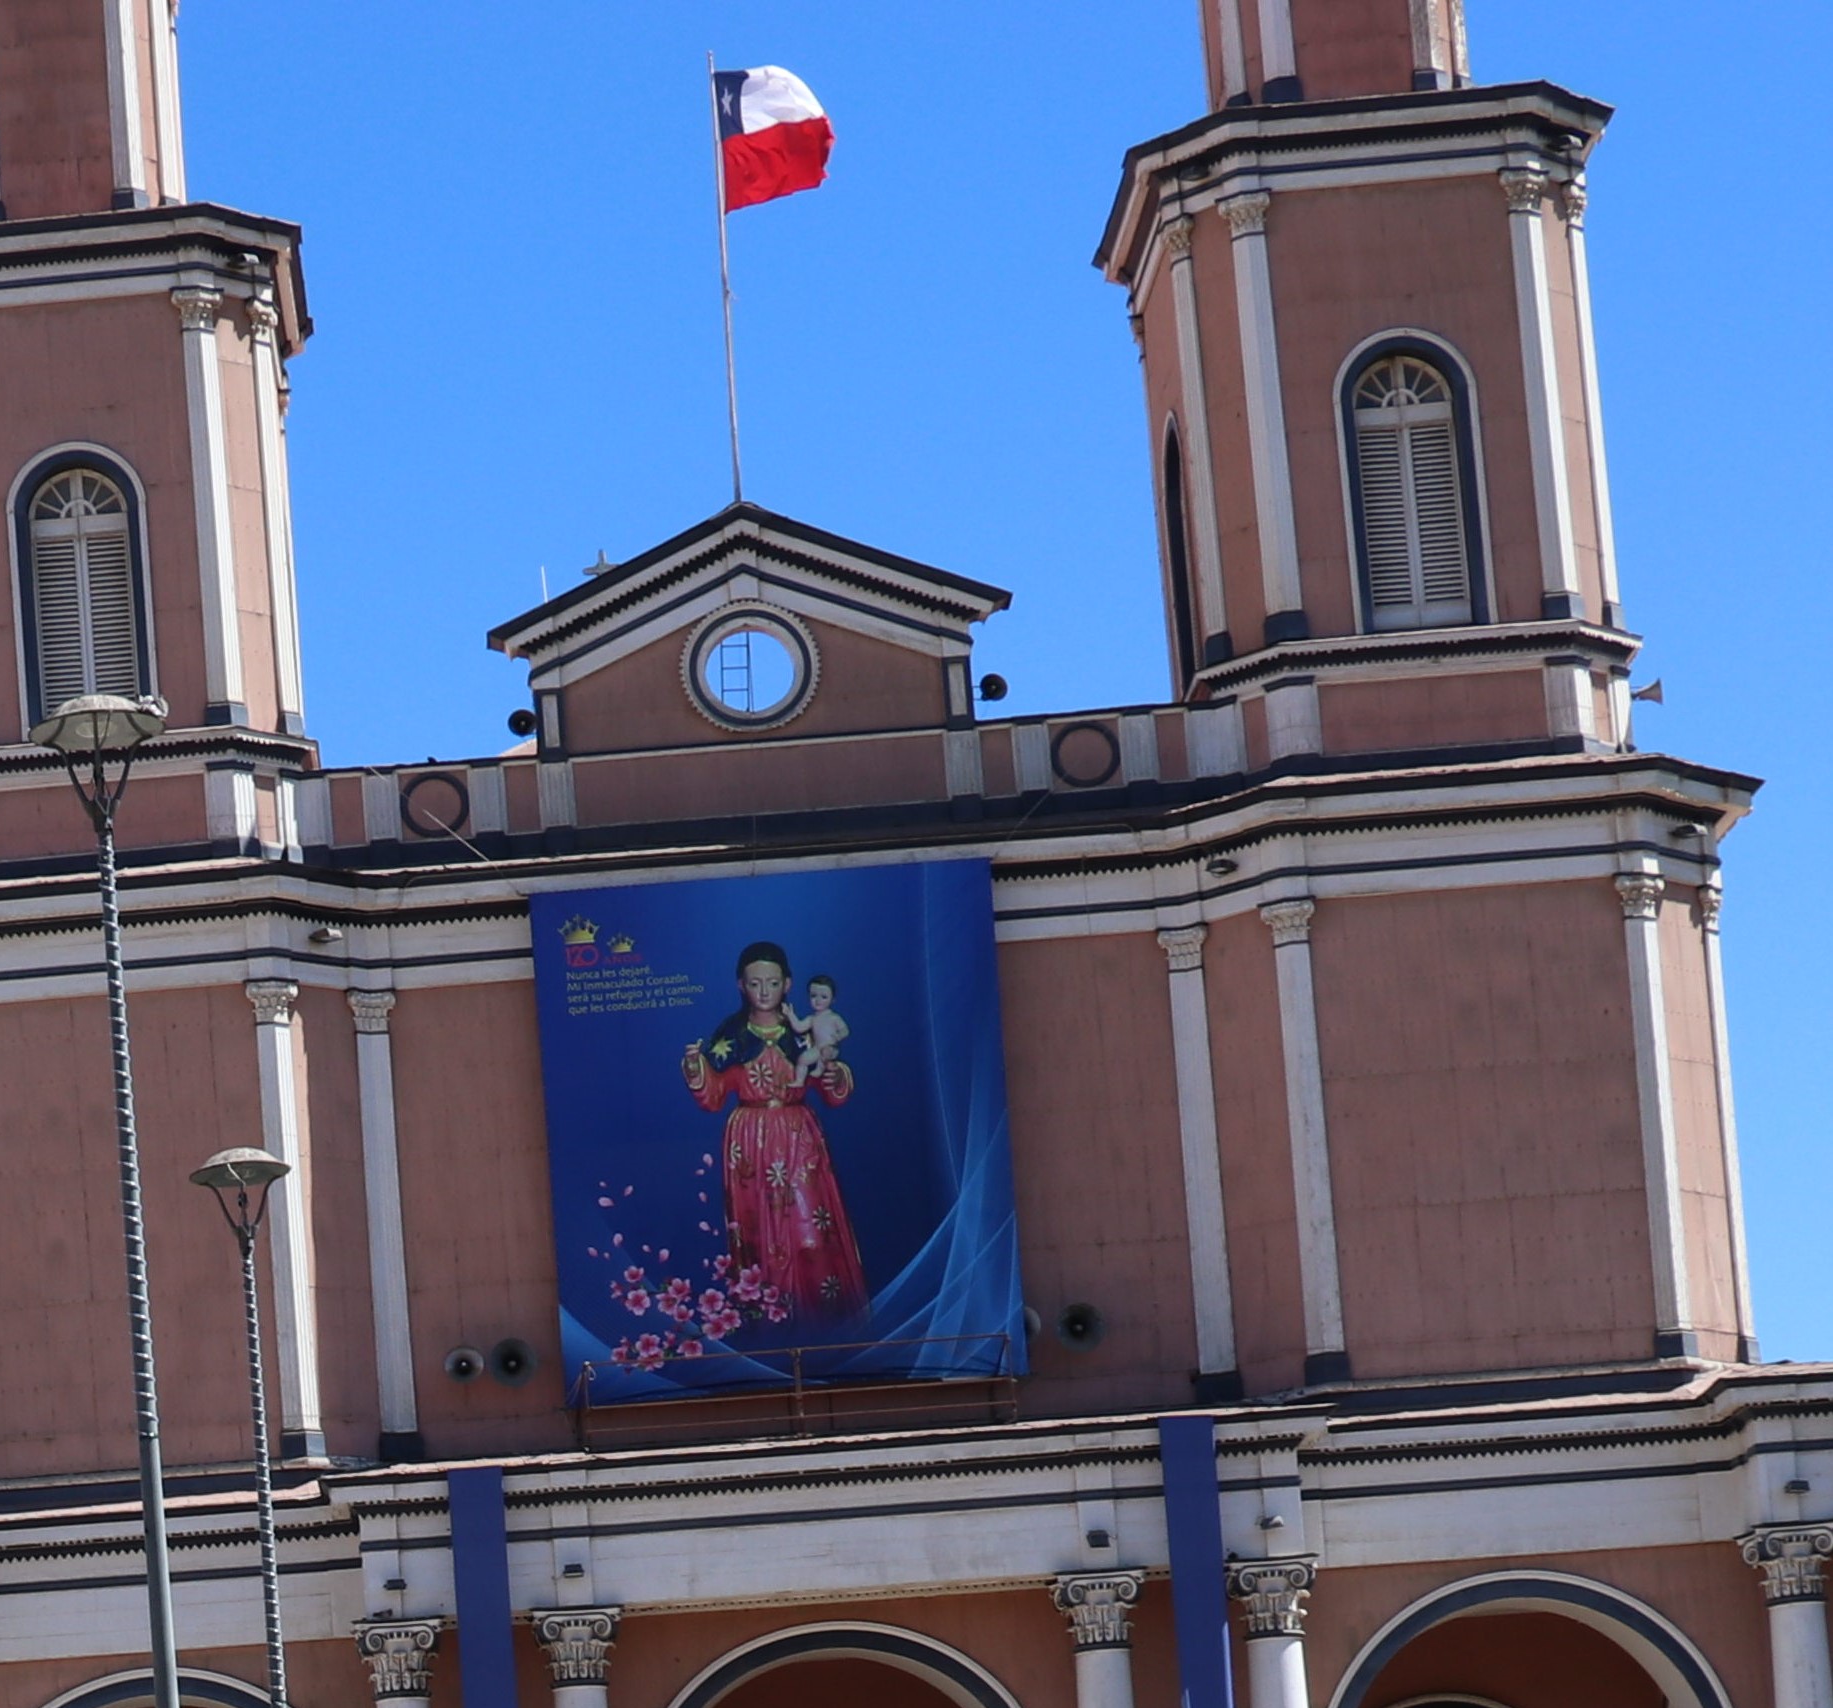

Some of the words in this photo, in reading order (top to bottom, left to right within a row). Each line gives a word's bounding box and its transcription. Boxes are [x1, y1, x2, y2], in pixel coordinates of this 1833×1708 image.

[566, 971, 600, 980] Nunca
[646, 974, 689, 986] Corazón
[591, 993, 603, 1001] su
[606, 988, 643, 1001] refugio
[654, 987, 664, 995] el
[666, 985, 704, 996] camino
[568, 1006, 588, 1016] que
[590, 1003, 604, 1013] les
